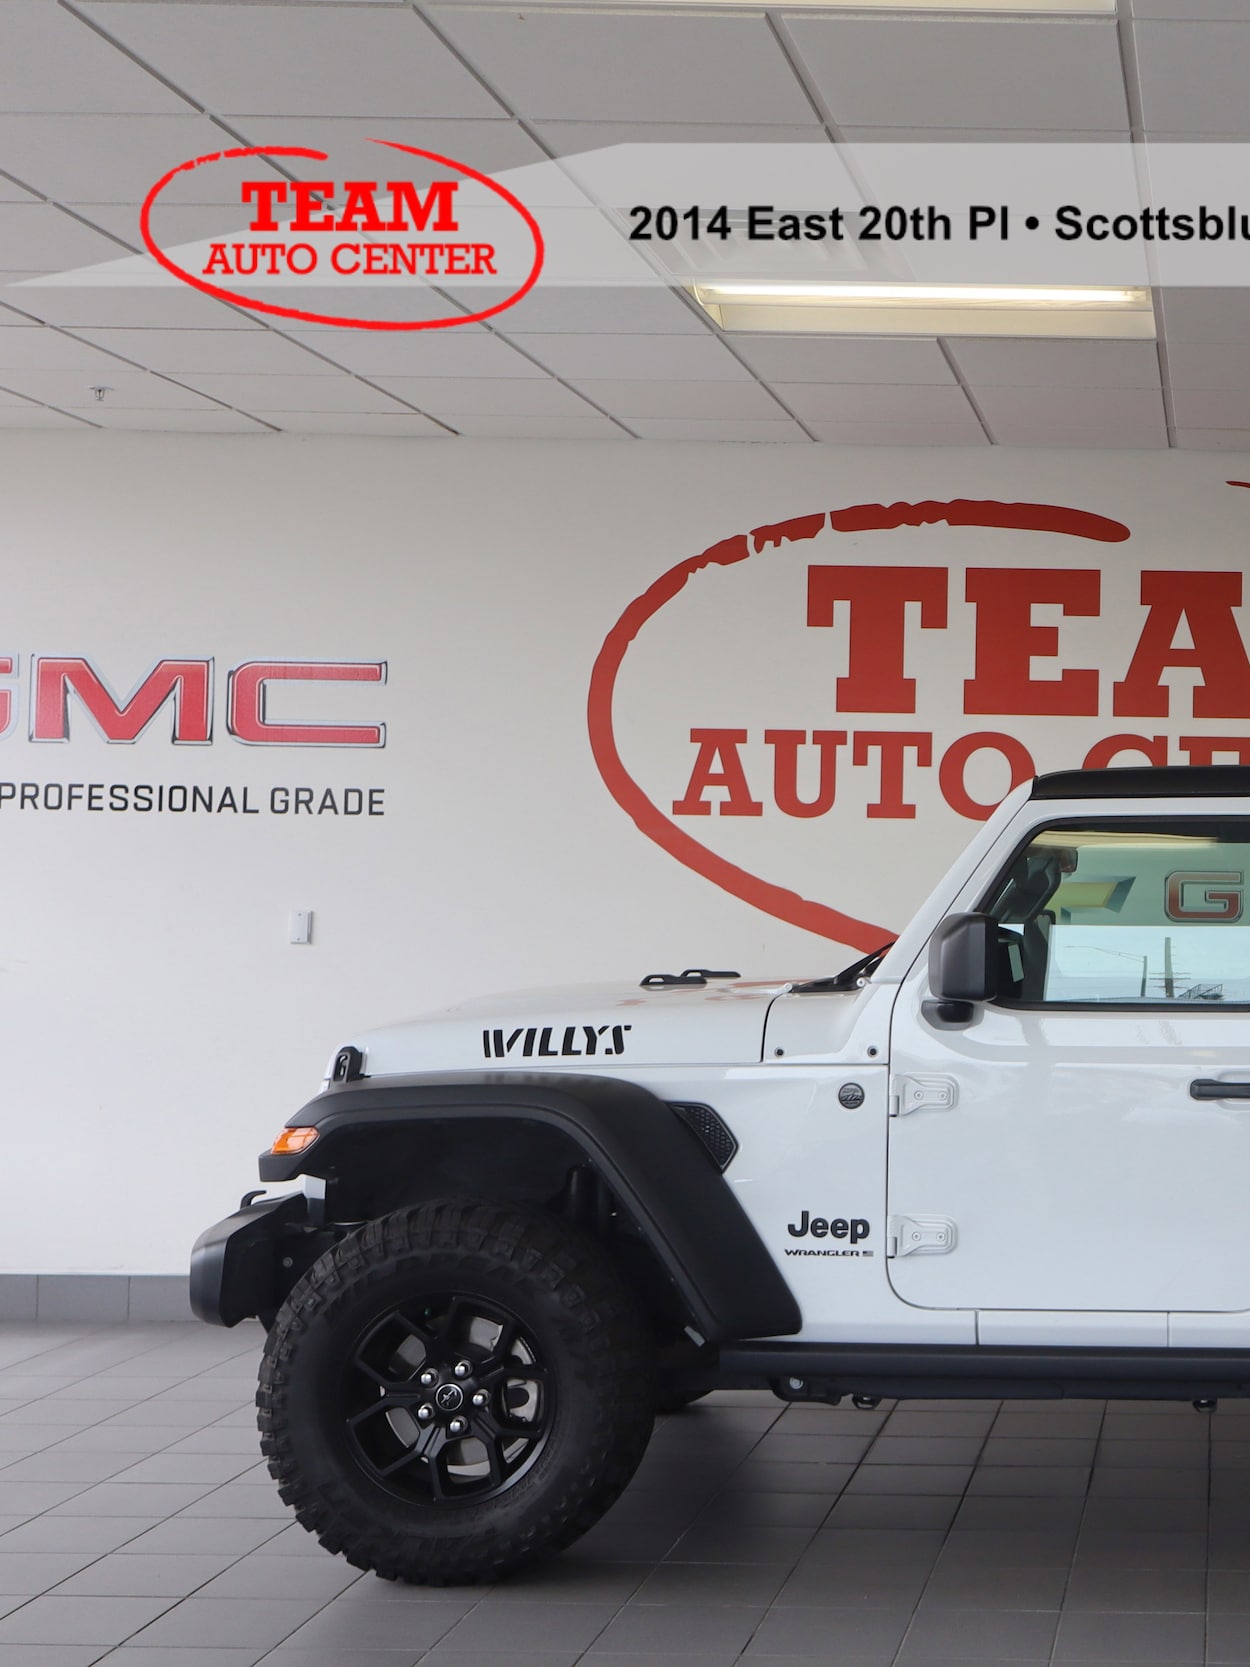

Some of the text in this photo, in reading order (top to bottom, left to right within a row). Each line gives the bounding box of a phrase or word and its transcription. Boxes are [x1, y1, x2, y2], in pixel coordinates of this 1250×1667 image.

[0, 652, 389, 749] MC
[672, 728, 1036, 822] AUTO
[0, 782, 386, 816] PROFESSIONAL GRADE
[482, 1025, 632, 1058] WILLYS
[787, 1210, 871, 1245] Jeep
[784, 1248, 860, 1257] WRANGLER
